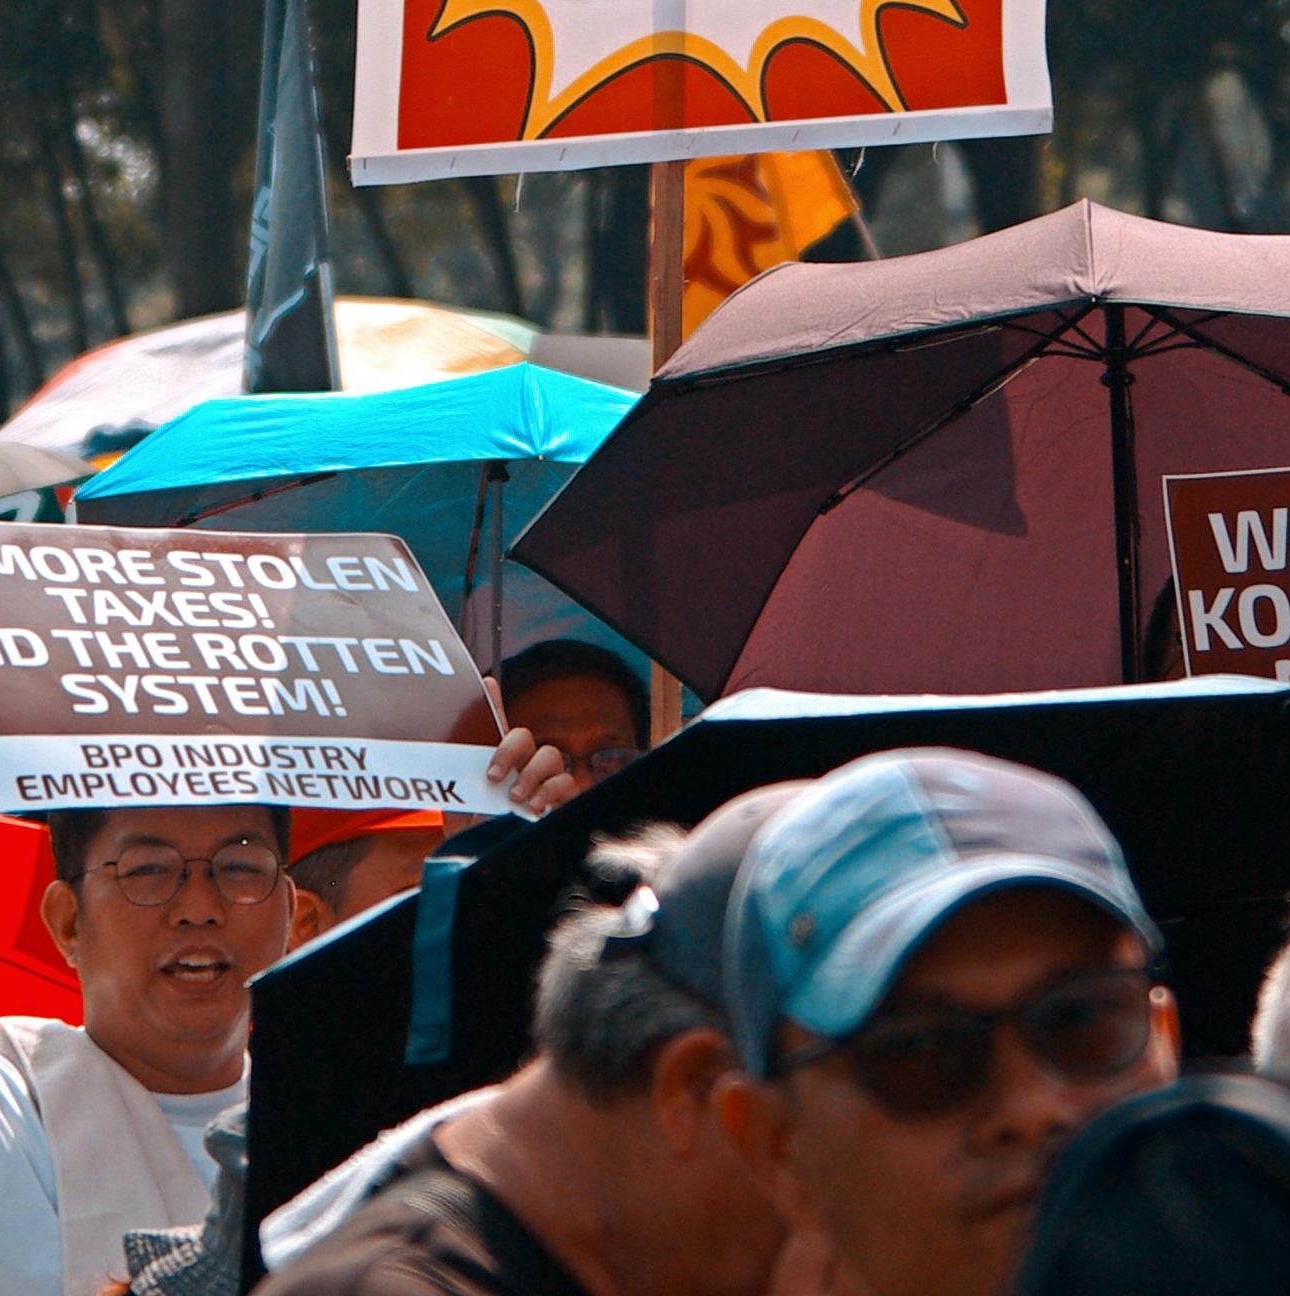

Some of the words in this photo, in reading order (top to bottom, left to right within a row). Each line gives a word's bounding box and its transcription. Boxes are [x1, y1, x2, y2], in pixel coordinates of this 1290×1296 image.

[166, 550, 419, 593] STOLEN
[43, 587, 276, 630] TAXES!
[50, 629, 192, 670] THE
[193, 632, 455, 676] ROTTEN
[60, 672, 348, 718] SYSTEM!
[80, 743, 164, 769] BPO
[171, 743, 368, 771] INDUSTRY
[15, 770, 259, 802] EMPLOYEES
[258, 772, 467, 804] NETWORK
